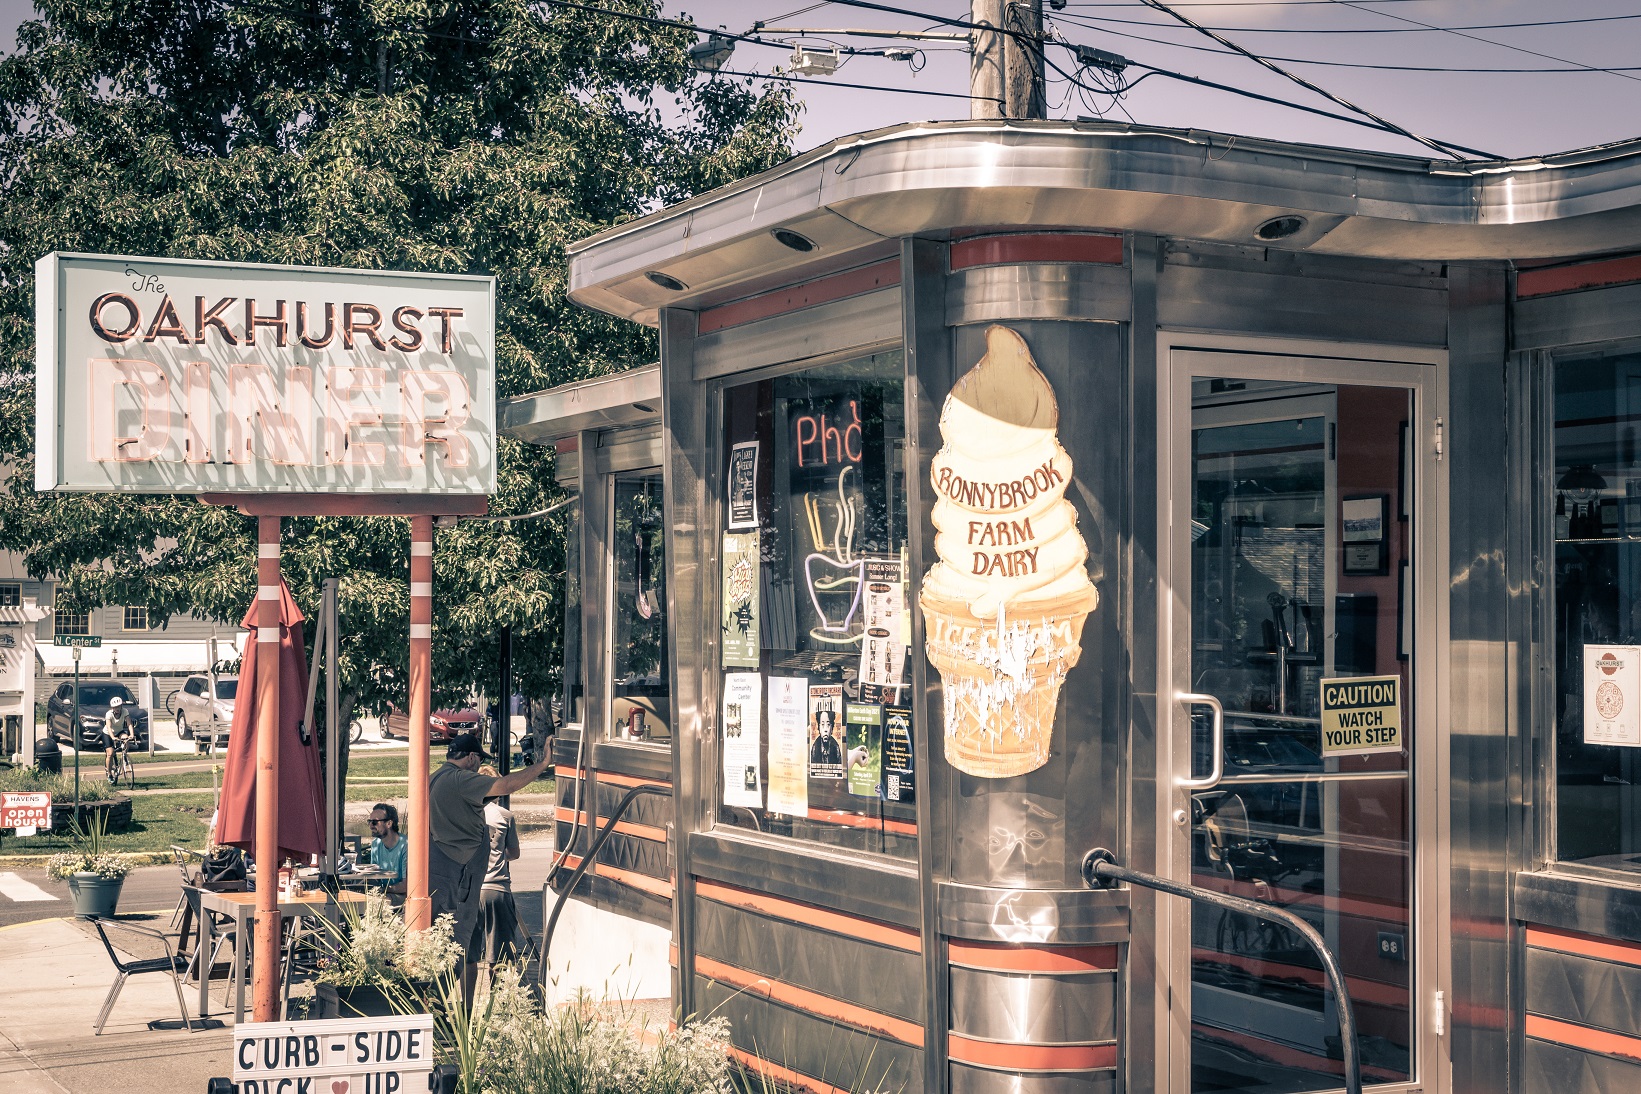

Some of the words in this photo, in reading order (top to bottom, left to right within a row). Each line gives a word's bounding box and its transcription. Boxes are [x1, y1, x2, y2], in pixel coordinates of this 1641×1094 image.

[125, 268, 166, 294] The
[88, 292, 465, 355] OAKHURST
[87, 357, 472, 468] DINER
[937, 457, 1064, 510] RONNYBROOK
[967, 516, 1036, 546] FARM
[972, 547, 1039, 578] DAIRY
[55, 636, 64, 645] N.
[65, 636, 93, 647] Center
[933, 617, 977, 645] ICE
[980, 619, 1075, 646] CAM
[1326, 684, 1394, 706] CAUTION
[1338, 711, 1383, 728] WATCH
[1326, 729, 1361, 746] YOUR
[1365, 727, 1397, 743] STEP
[5, 815, 46, 826] house
[8, 809, 43, 818] open
[365, 1071, 400, 1094] UP
